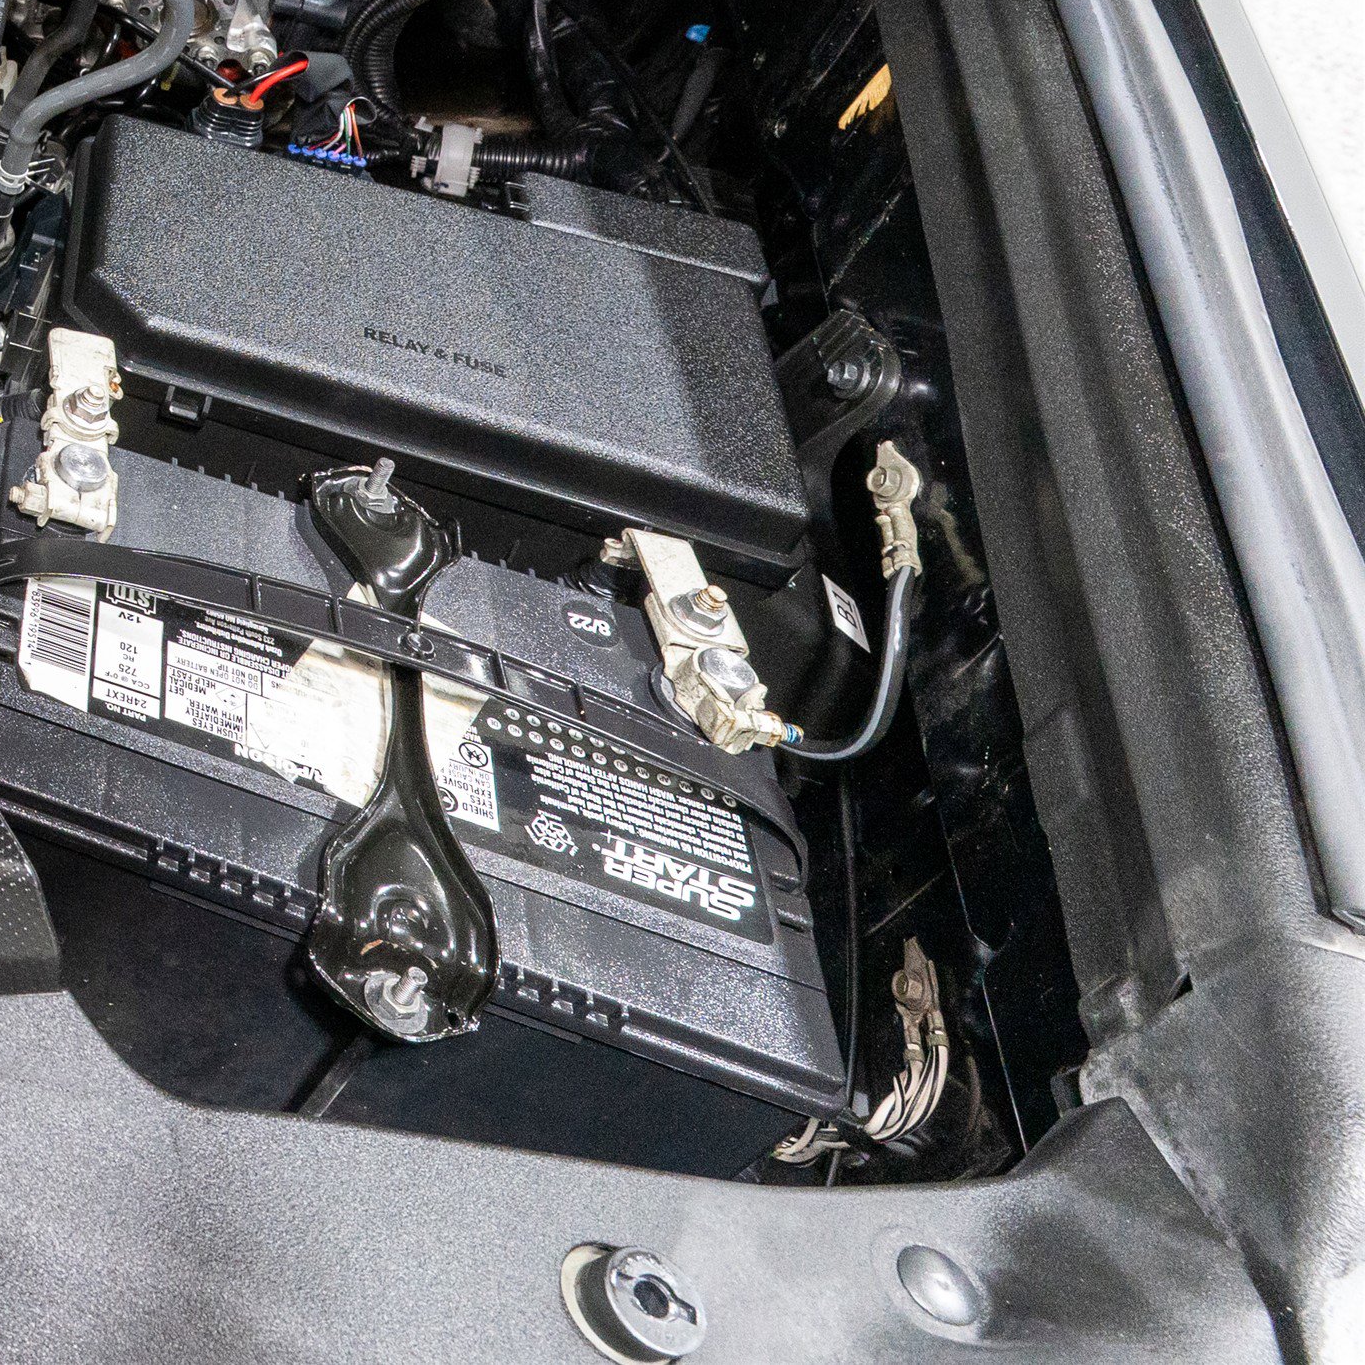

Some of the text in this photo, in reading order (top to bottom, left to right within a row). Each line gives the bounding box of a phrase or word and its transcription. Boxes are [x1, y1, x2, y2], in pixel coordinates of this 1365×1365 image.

[362, 326, 509, 379] RELAY & FUSE
[29, 590, 40, 617] 83996
[117, 610, 141, 623] 12V
[566, 610, 612, 639] 8/22
[26, 622, 37, 648] 19514
[176, 634, 218, 655] INCINERATE.
[179, 628, 232, 653] INSTRUCTIONS.
[118, 641, 138, 654] 120
[121, 652, 135, 662] RC
[218, 649, 230, 659] OR
[233, 646, 270, 665] CHARGING
[117, 663, 137, 677] 725
[174, 655, 258, 690] DO NOT OPEN BATTERY.
[214, 661, 259, 682] DO NOT TIP.
[230, 652, 279, 676] DISASSEMBLE
[130, 678, 150, 689] CCA
[167, 674, 206, 695] MEDICAL
[168, 666, 215, 689] HELP FAST.
[104, 687, 146, 709] 24REXT
[167, 683, 184, 695] GET
[104, 701, 146, 722] PART NO.
[184, 705, 243, 733] IMMEDIATELY
[186, 697, 242, 724] WITH WATER.
[191, 716, 242, 741] FLUSH EYES
[447, 761, 475, 776] INJURY
[524, 753, 564, 774] California
[533, 765, 551, 778] also
[543, 751, 590, 773] HANDLING.
[447, 768, 473, 782] CAUSE
[474, 778, 490, 788] CAN
[477, 771, 489, 781] OR
[530, 772, 569, 793] California
[551, 770, 587, 791] Batteries
[572, 769, 596, 784] State
[589, 766, 618, 783] AFTER
[595, 777, 612, 790] the
[439, 775, 491, 799] EXPLOSIVE
[618, 776, 647, 793] HANDS
[619, 784, 648, 801] known
[648, 785, 676, 802] WASH
[581, 789, 601, 804] State
[601, 796, 616, 809] the
[614, 791, 664, 816] reproductive
[647, 793, 689, 815] chemicals
[460, 801, 494, 820] SHIELD
[625, 804, 653, 821] known
[664, 808, 680, 821] and
[689, 808, 712, 823] other
[706, 804, 731, 820] cause
[653, 813, 695, 835] chemicals
[681, 814, 708, 831] cancer
[710, 823, 735, 839] cause
[712, 815, 743, 832] contain
[690, 845, 751, 873] PROPOSITION
[599, 839, 757, 906] START
[602, 856, 742, 921] SUPER
